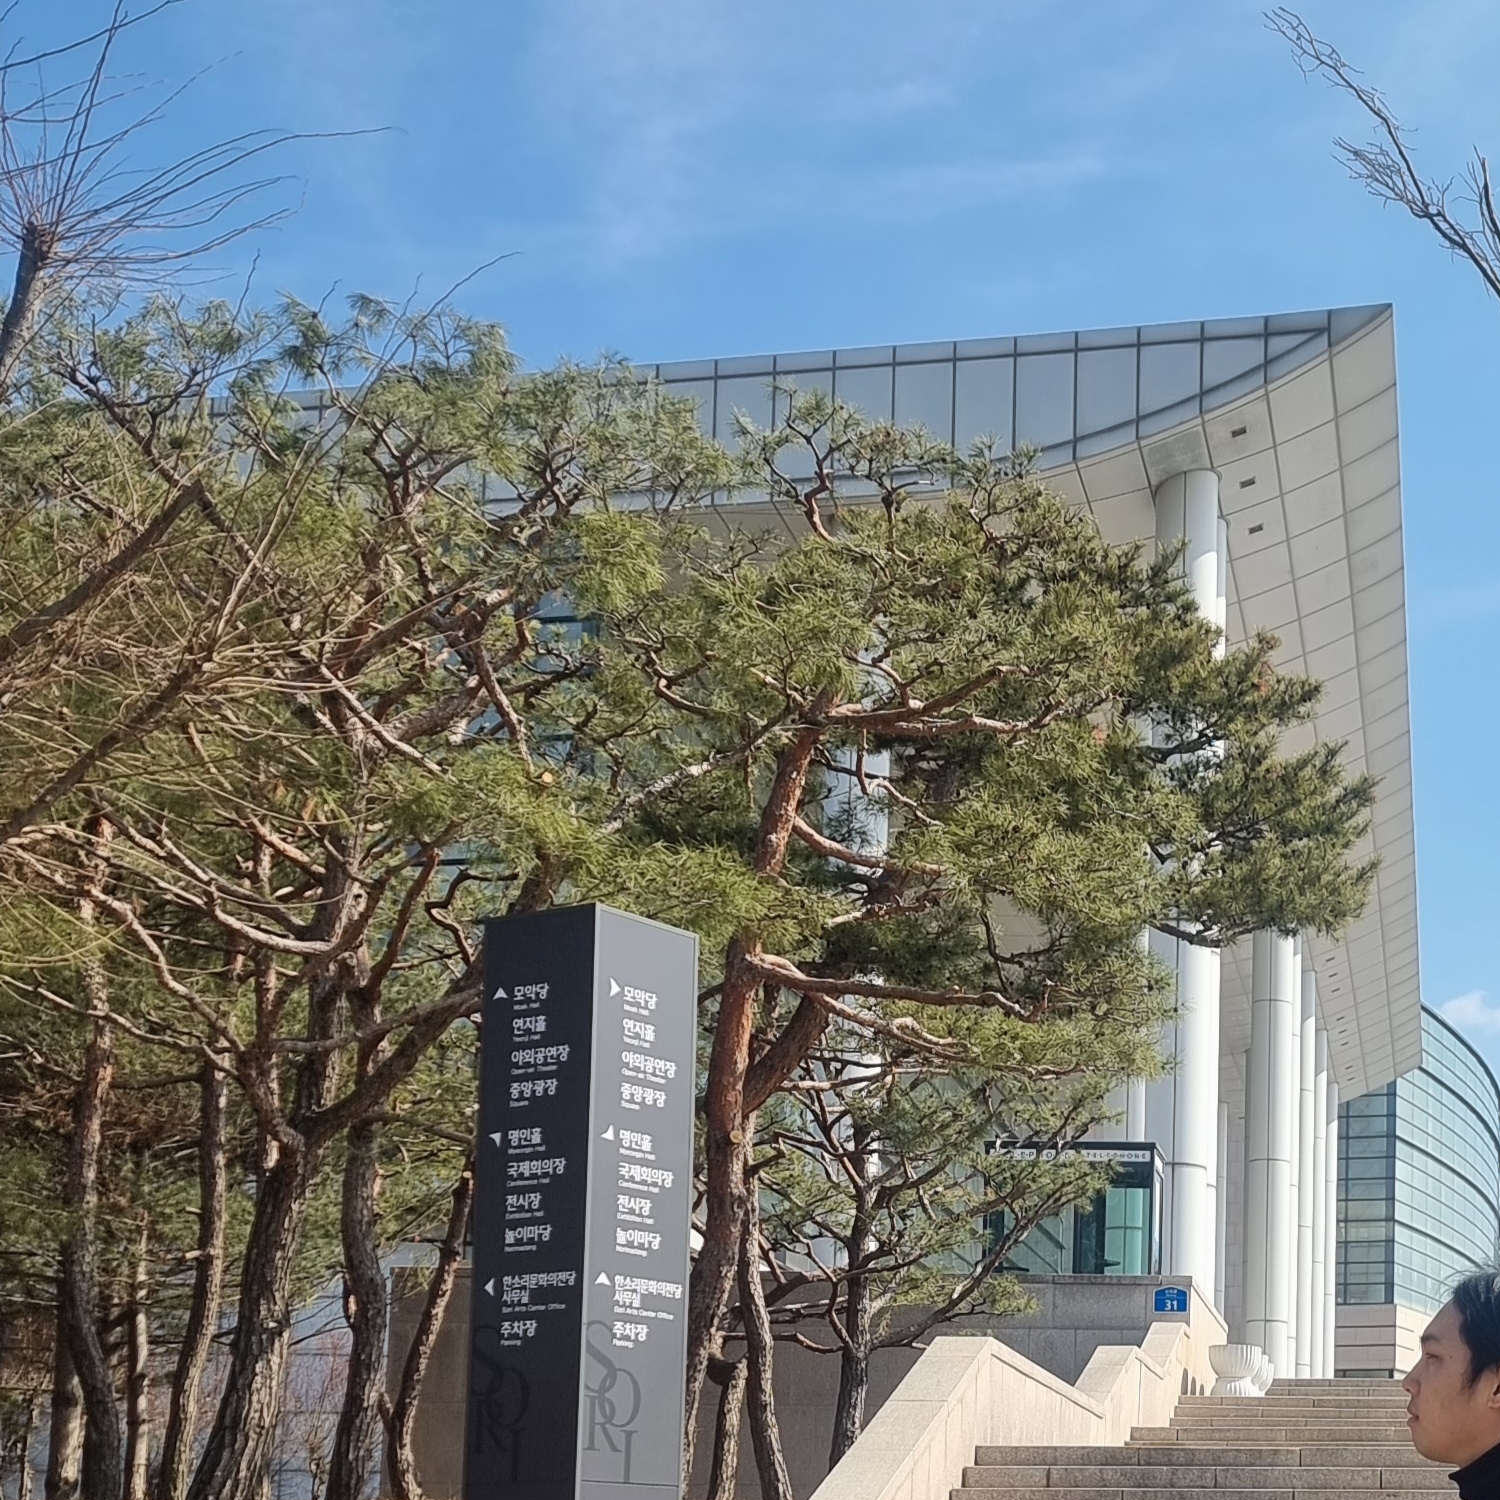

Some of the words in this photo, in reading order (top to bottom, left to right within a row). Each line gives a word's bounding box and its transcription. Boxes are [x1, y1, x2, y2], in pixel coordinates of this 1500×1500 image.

[513, 983, 550, 1001] 모악당
[623, 986, 659, 1010] 모악당
[512, 1015, 547, 1034] 연지홀
[622, 1018, 656, 1042] 연지홀
[511, 1044, 571, 1066] 야외공연장
[621, 1051, 677, 1079] 야외공연장
[509, 1078, 558, 1099] 중앙광장
[620, 1082, 667, 1108] 중앙광장
[508, 1127, 542, 1146] 명인홀
[619, 1129, 652, 1152] 명인홀
[506, 1157, 567, 1178] 국제회의장
[618, 1162, 674, 1188] 국제회의장
[505, 1192, 542, 1211] 전시장
[617, 1195, 652, 1216] 전시장
[505, 1224, 553, 1244] 놀이마당
[616, 1227, 662, 1250] 놀이마당
[502, 1289, 529, 1304] 사무실
[613, 1291, 641, 1307] 사무실
[1164, 1299, 1178, 1311] 31
[500, 1320, 537, 1338] 주차장
[612, 1321, 649, 1341] 주차장
